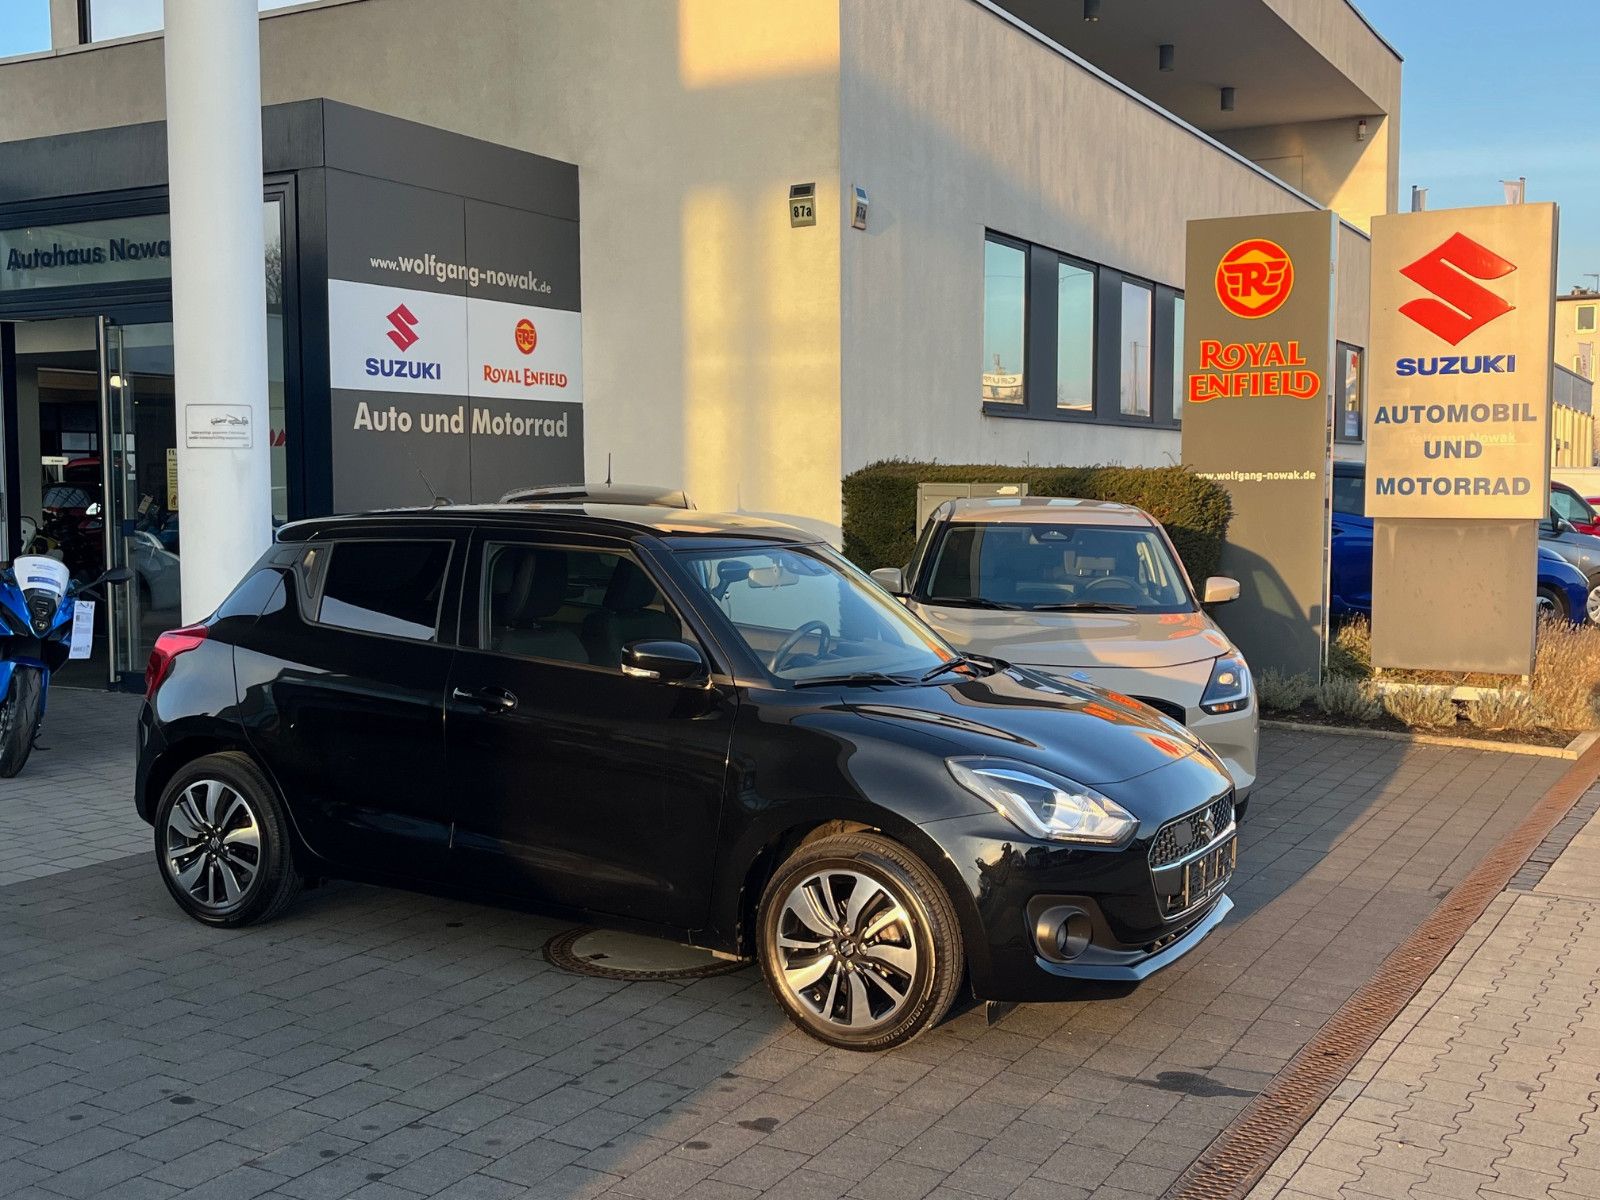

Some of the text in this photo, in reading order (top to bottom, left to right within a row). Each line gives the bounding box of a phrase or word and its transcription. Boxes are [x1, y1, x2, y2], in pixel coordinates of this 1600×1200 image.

[793, 205, 812, 218] 87a
[7, 238, 170, 270] Autohaus Nowa
[370, 254, 552, 294] www.wolfgang-nowak.de
[1200, 340, 1307, 371] ROYAL
[1396, 355, 1516, 376] SUZUKI
[365, 358, 441, 380] SUZUKI
[483, 364, 568, 388] ROYAL ENFIELD
[1188, 371, 1320, 402] ENFIELD
[353, 402, 569, 438] Auto und Motorrad
[1374, 403, 1537, 425] AUTOMOBIL
[1424, 440, 1483, 459] UND
[1195, 470, 1317, 482] ww.wolfgang-nowak.de
[1376, 477, 1531, 496] MOTORRAD
